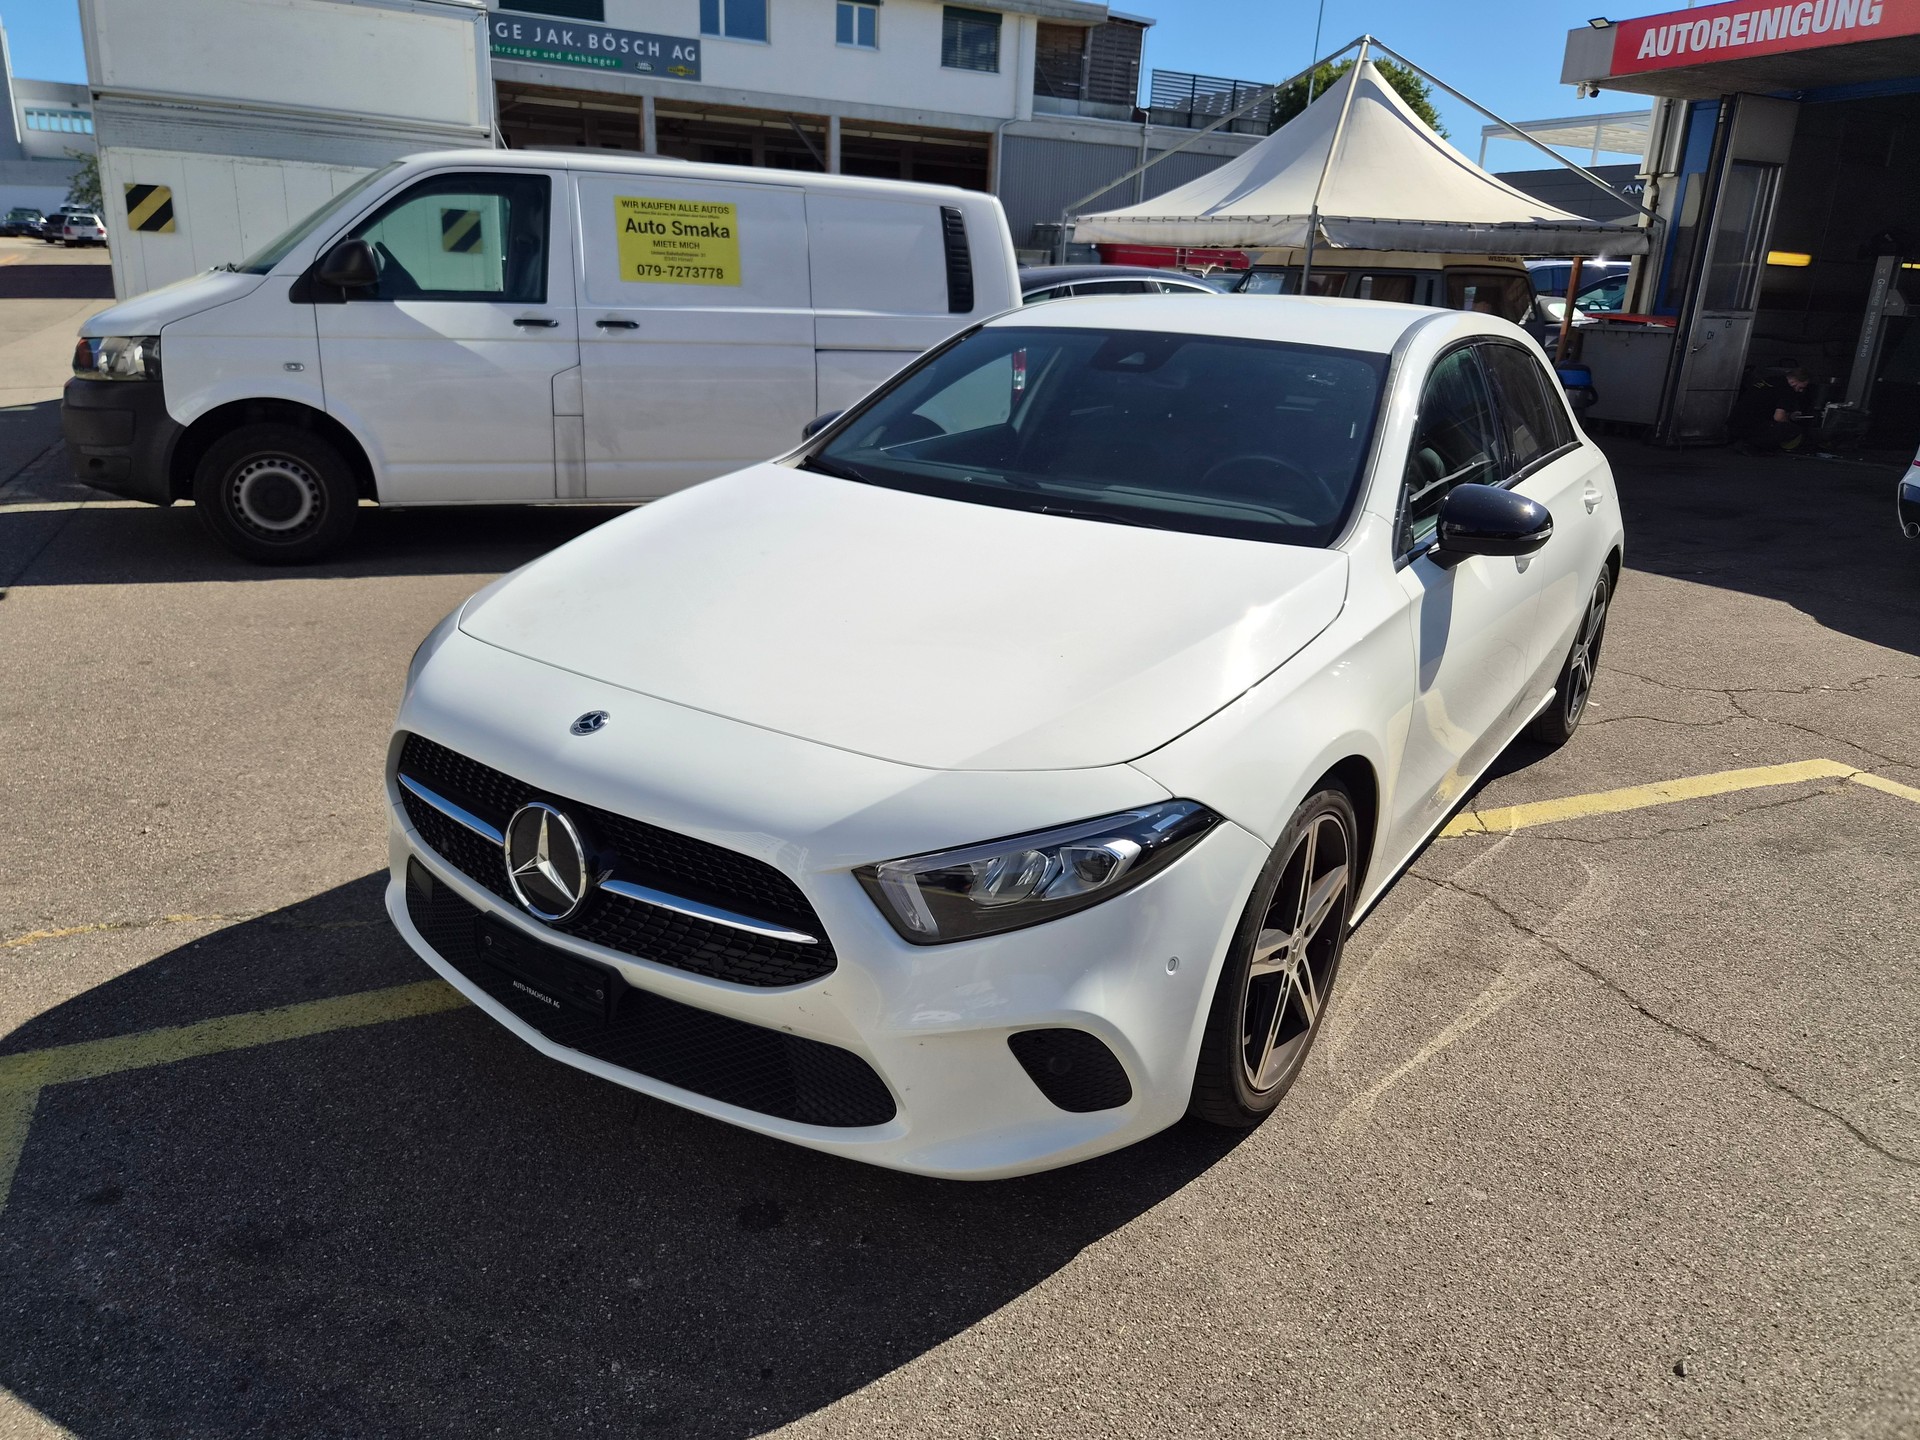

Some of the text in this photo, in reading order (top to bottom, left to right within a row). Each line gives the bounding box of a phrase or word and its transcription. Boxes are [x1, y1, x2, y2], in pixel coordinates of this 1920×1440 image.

[1637, 0, 1883, 60] AUTOREINIGUNG
[488, 22, 696, 62] GE JAK. BÖSCH AG
[543, 50, 562, 60] und
[567, 53, 617, 67] Anhänger
[621, 200, 639, 209] WIR
[641, 201, 676, 212] KAUFEN
[678, 204, 699, 213] ALLE
[701, 205, 730, 215] AUTOS
[625, 218, 731, 239] Auto Smaka
[653, 240, 700, 250] MIETE MICH
[637, 264, 724, 280] 079-7273778
[513, 980, 561, 1008] AUTO-TRACHSLER AG
